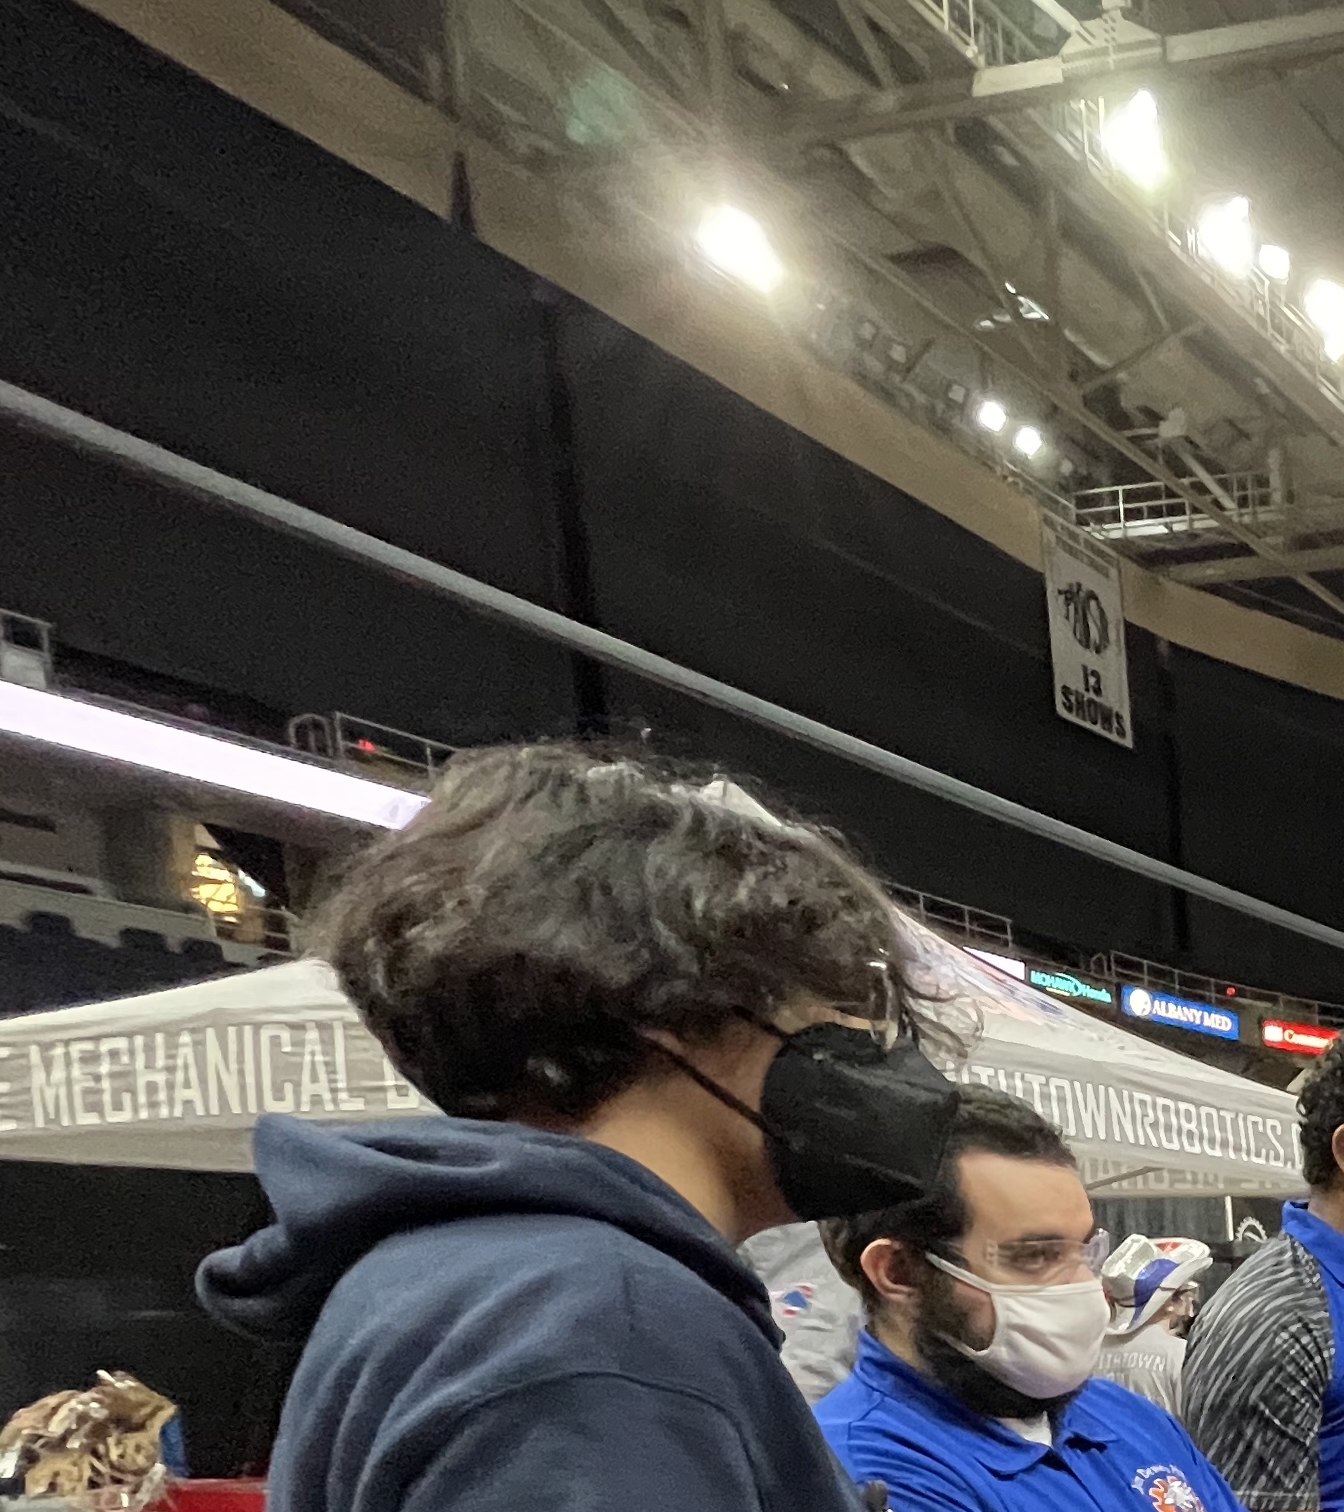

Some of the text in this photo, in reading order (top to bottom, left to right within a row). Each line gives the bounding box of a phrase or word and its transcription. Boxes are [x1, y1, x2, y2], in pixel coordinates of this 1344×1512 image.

[1061, 684, 1127, 740] SHOWS
[1151, 999, 1232, 1032] ALBANY MED
[30, 1019, 366, 1128] MECHANICAL
